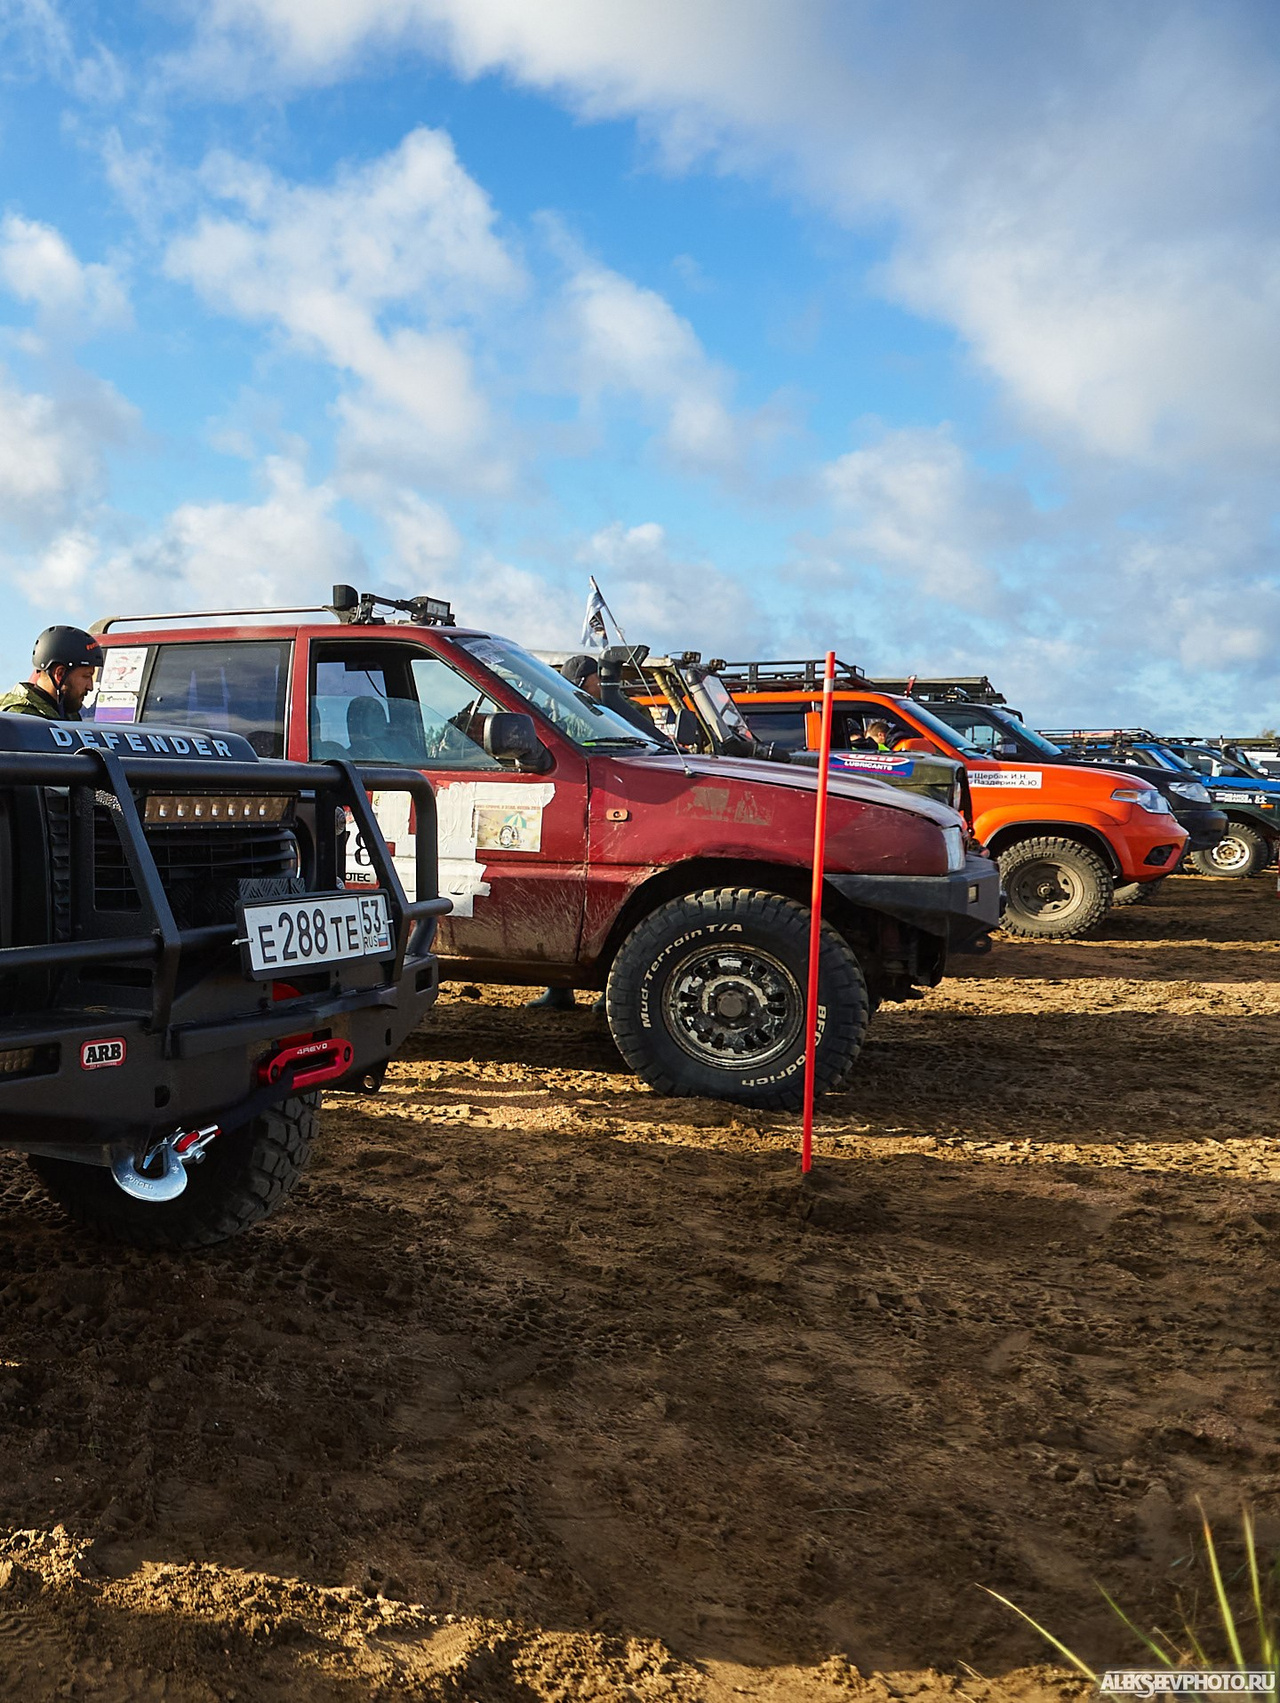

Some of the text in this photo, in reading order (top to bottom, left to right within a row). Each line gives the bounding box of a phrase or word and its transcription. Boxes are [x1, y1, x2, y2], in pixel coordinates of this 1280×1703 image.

[49, 725, 233, 759] DEFENDER
[974, 772, 1009, 782] Щербак
[361, 900, 382, 934] 53
[364, 935, 379, 949] RUS
[640, 923, 744, 1029] Mud-Terrain T/A
[85, 1043, 122, 1064] ARB
[296, 1042, 328, 1055] 4REVO
